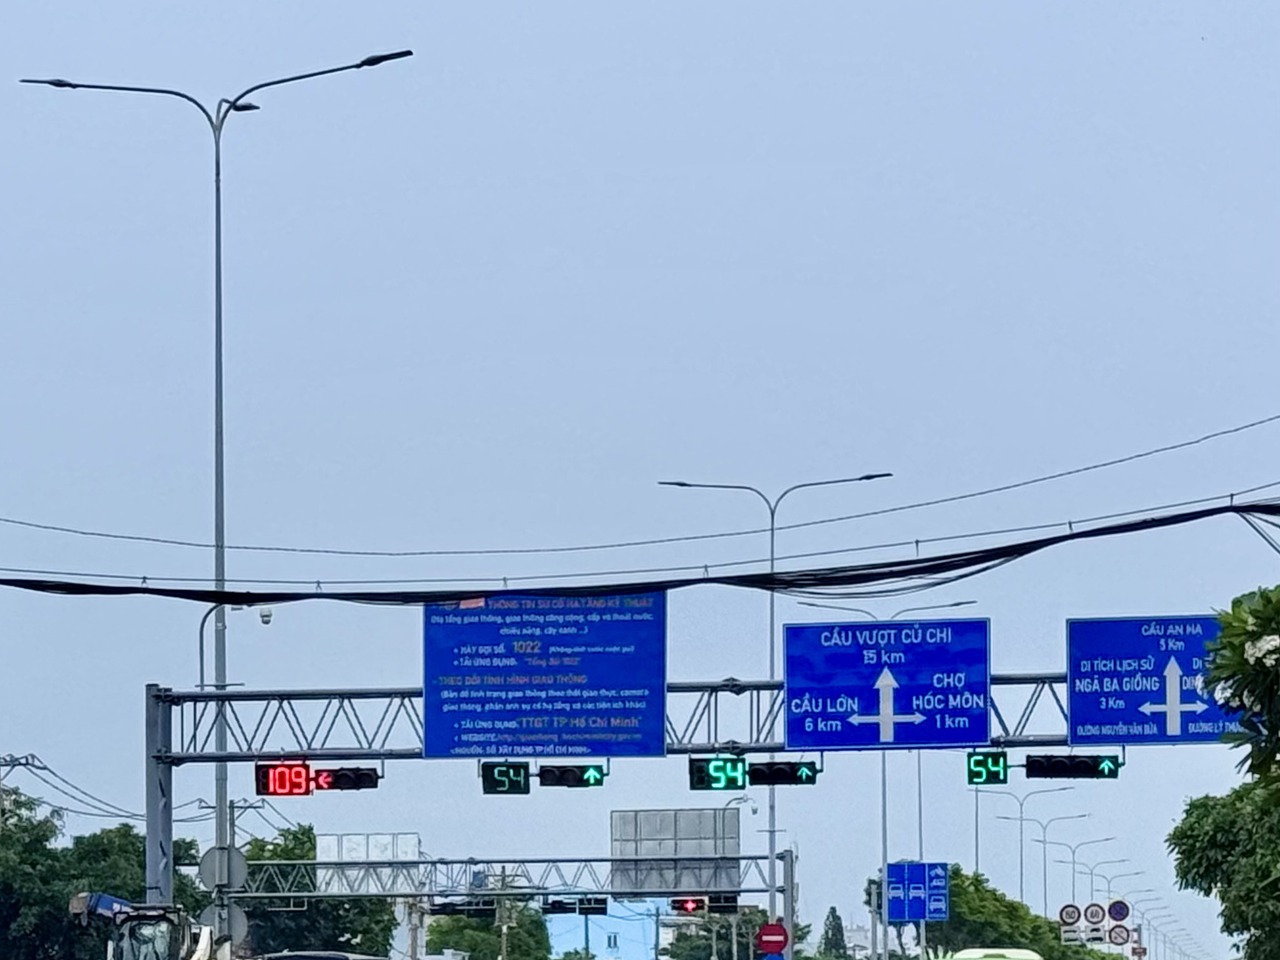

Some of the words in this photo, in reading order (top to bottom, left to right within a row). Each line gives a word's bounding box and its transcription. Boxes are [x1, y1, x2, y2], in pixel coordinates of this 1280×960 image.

[821, 626, 852, 646] CẦU
[856, 629, 897, 647] VƯỢT
[901, 623, 922, 644] CỦ
[926, 627, 952, 644] CHI
[1166, 624, 1184, 635] AN
[512, 640, 541, 653] 1022
[1168, 639, 1185, 651] Km
[881, 649, 905, 664] km
[1192, 658, 1203, 670] DI
[1080, 660, 1091, 673] DI
[1093, 657, 1114, 672] TÍCH
[1116, 659, 1139, 674] LỊCH
[932, 672, 966, 689] CHỢ
[1075, 675, 1100, 693] NGÃ
[1104, 678, 1120, 692] BA
[791, 692, 822, 713] CẦU
[912, 690, 945, 710] HÓC
[948, 691, 984, 709] MÔN
[1100, 698, 1106, 710] 3
[1108, 697, 1125, 709] Km
[805, 717, 813, 732] 6
[817, 717, 842, 732] km
[935, 714, 941, 728] 1
[945, 713, 969, 728] km
[709, 761, 743, 788] 54
[970, 756, 1004, 782] 54
[268, 767, 306, 793] 109
[494, 767, 524, 791] 54
